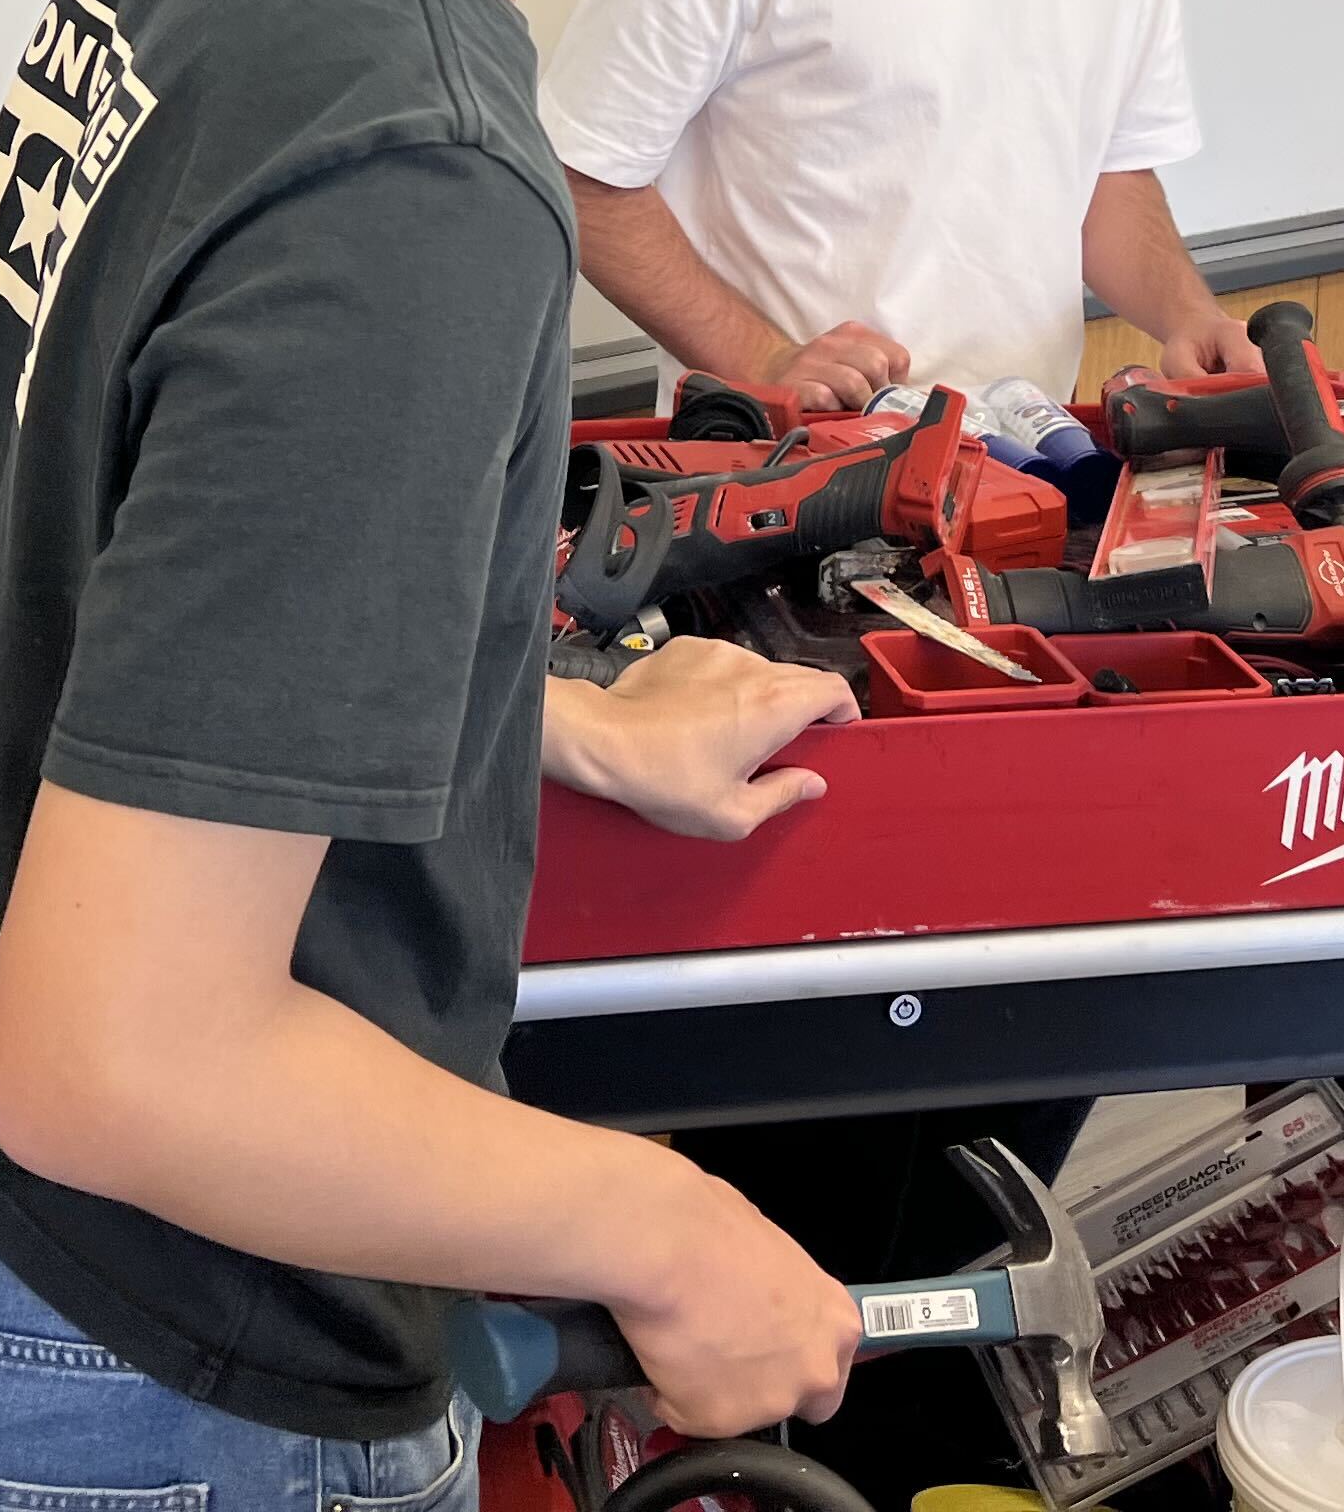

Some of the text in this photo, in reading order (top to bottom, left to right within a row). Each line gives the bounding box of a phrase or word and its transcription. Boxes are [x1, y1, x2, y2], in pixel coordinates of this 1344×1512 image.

[767, 512, 777, 524] 2
[962, 567, 982, 619] FUEL
[1112, 1153, 1236, 1227] SPEEDEMON
[1133, 1199, 1173, 1226] PIECE
[1176, 1172, 1223, 1202] SPADE
[1225, 1158, 1248, 1174] BIT
